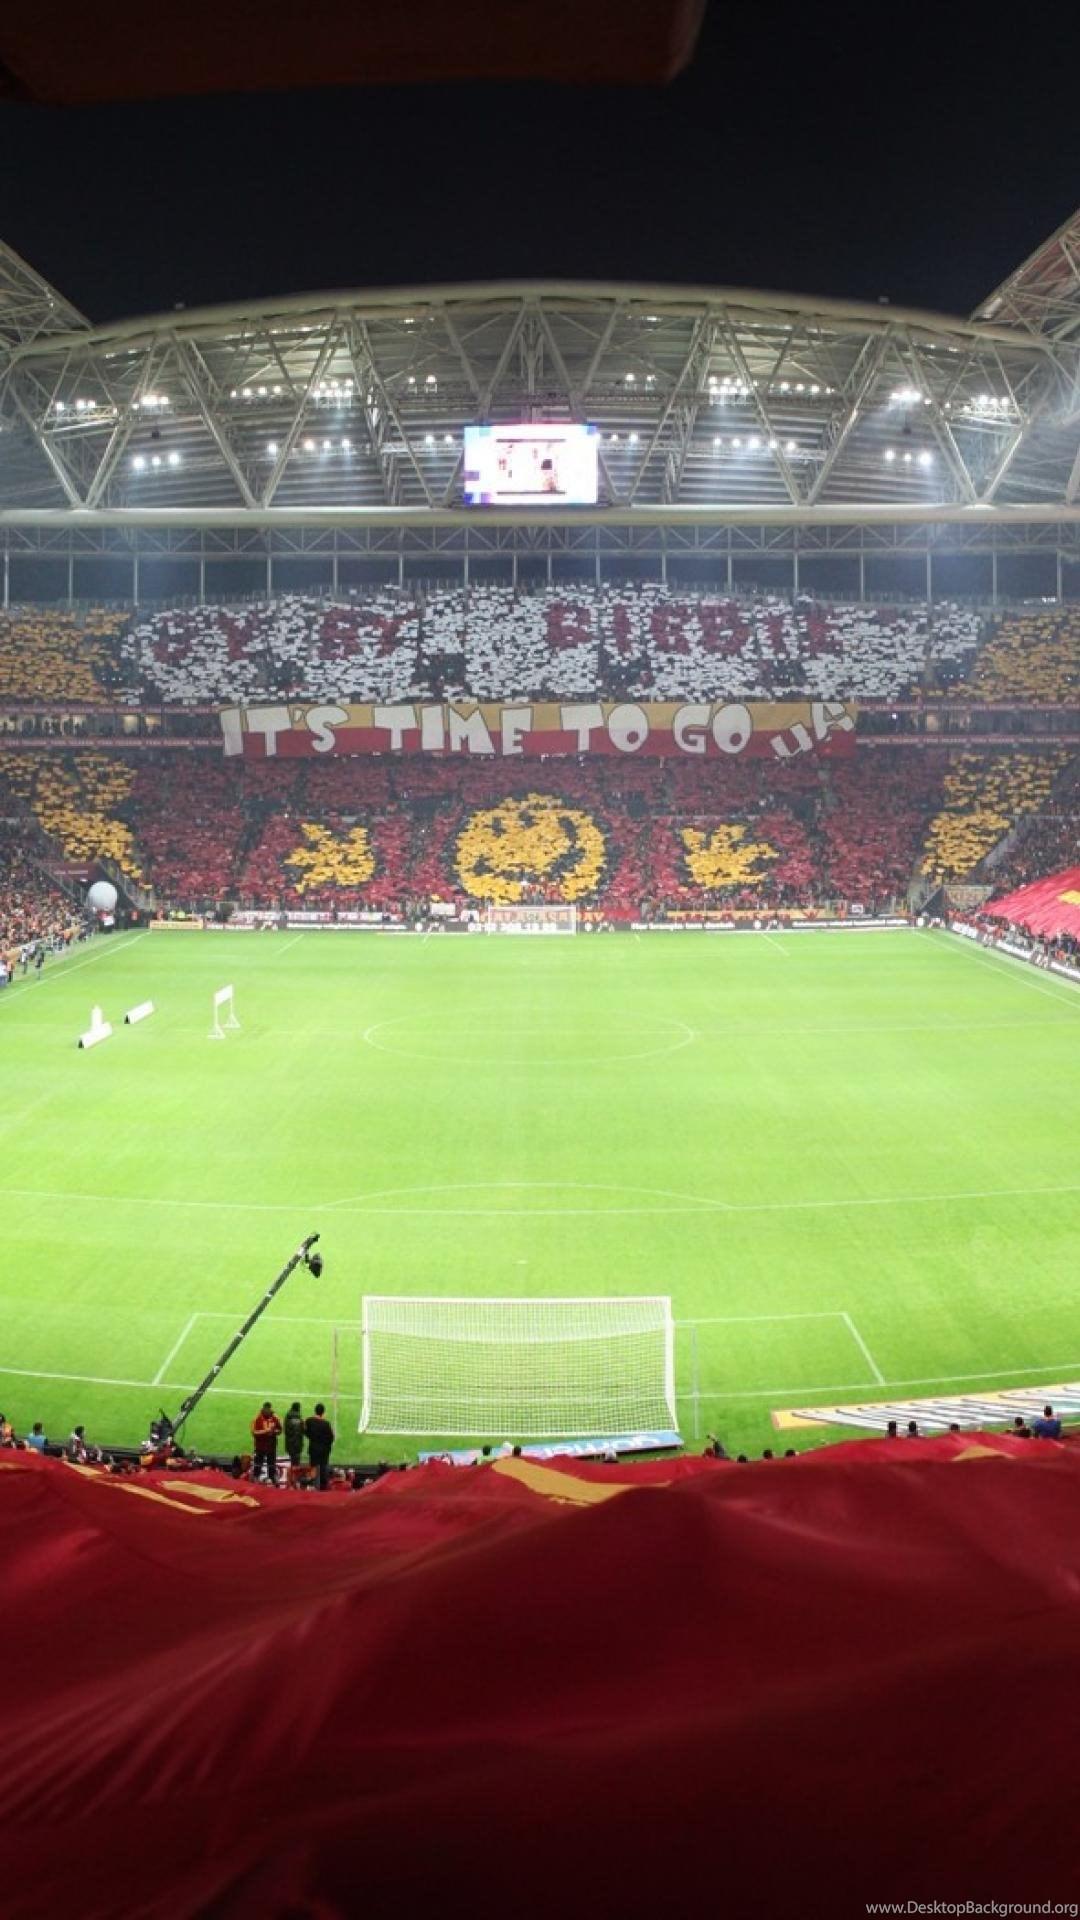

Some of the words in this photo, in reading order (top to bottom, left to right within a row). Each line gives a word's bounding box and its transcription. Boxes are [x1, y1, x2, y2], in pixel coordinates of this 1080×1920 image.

[219, 705, 350, 756] IT'S
[373, 703, 533, 756] TIME
[560, 702, 648, 753] TO
[673, 702, 752, 754] GO
